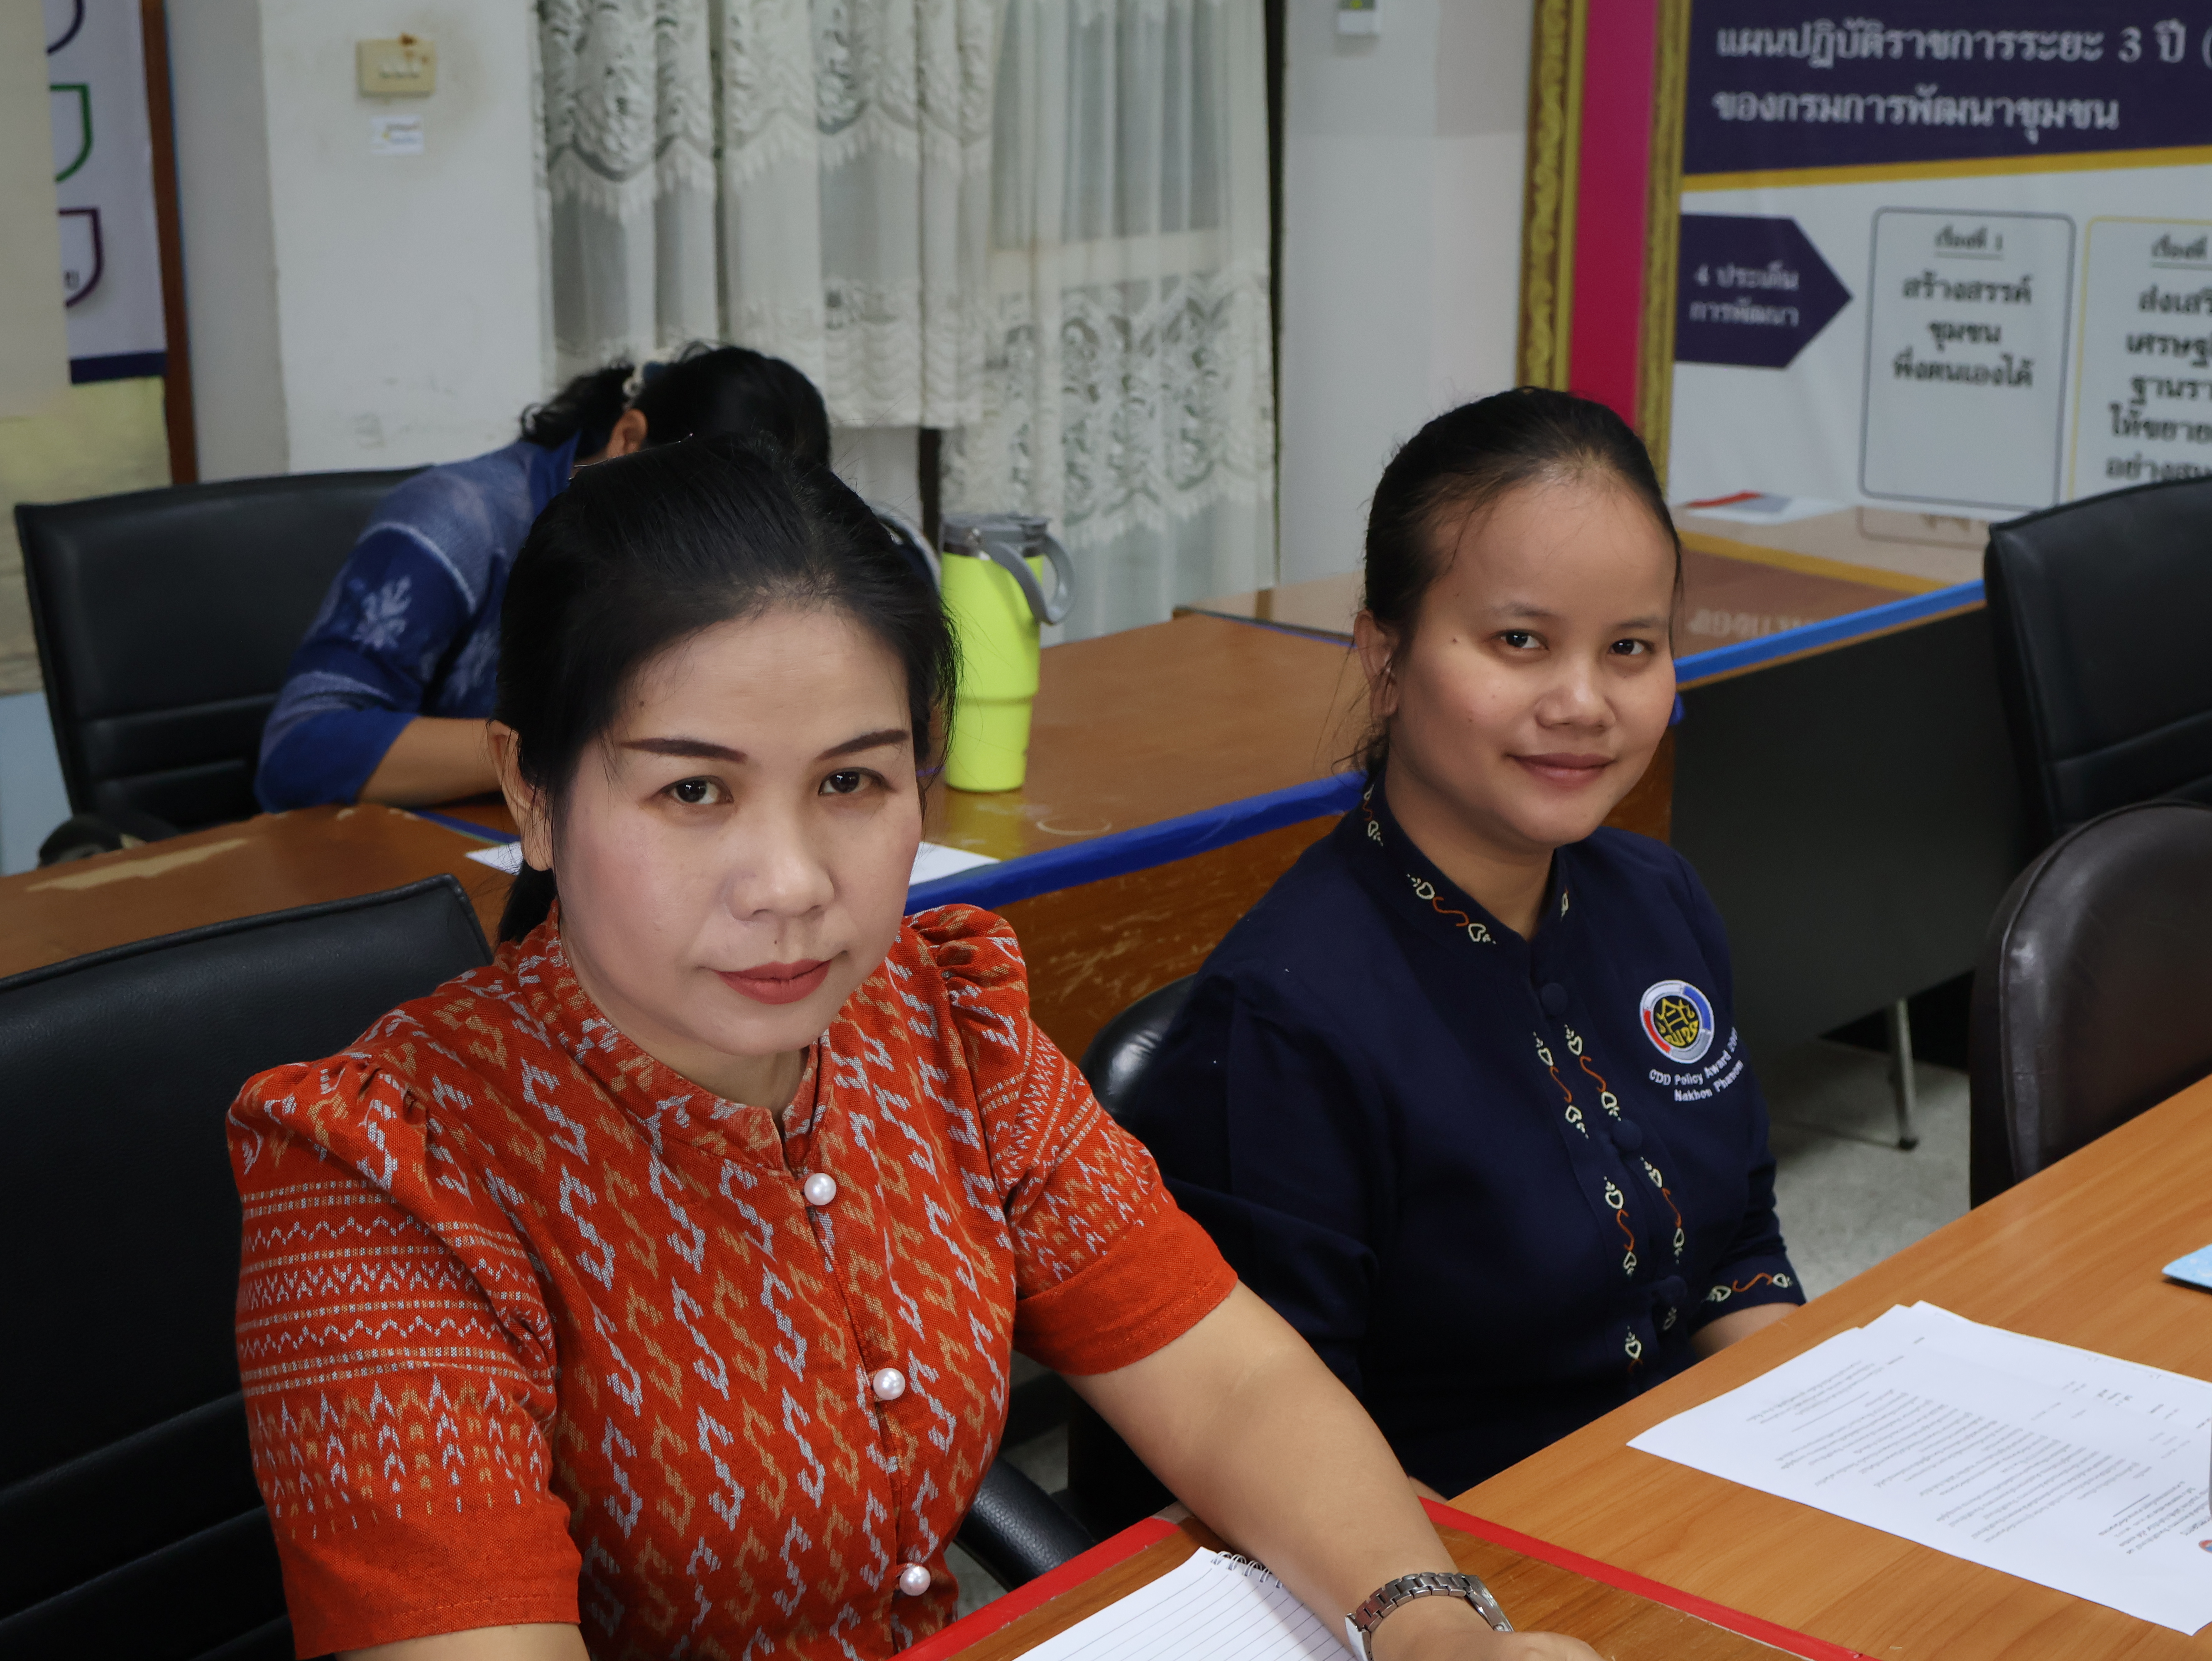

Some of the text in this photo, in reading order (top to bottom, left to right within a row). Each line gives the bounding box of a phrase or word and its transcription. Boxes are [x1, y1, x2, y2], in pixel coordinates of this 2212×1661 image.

[1717, 17, 2104, 69] แผนปฏิบัติราชการระยะ
[2118, 26, 2141, 63] 3
[2153, 18, 2185, 63] ปี
[1711, 83, 2119, 144] ของกรมการพัฒนาชุมชน
[1904, 269, 2032, 305] สร้างสรรค์
[1930, 321, 2002, 352] ชุมชน
[2126, 332, 2212, 369] เศรษฐ
[1649, 1069, 1671, 1085] CDD
[1674, 1073, 1703, 1085] Policy
[1703, 1049, 1732, 1079] Award
[1674, 1089, 1713, 1102] Nakhon
